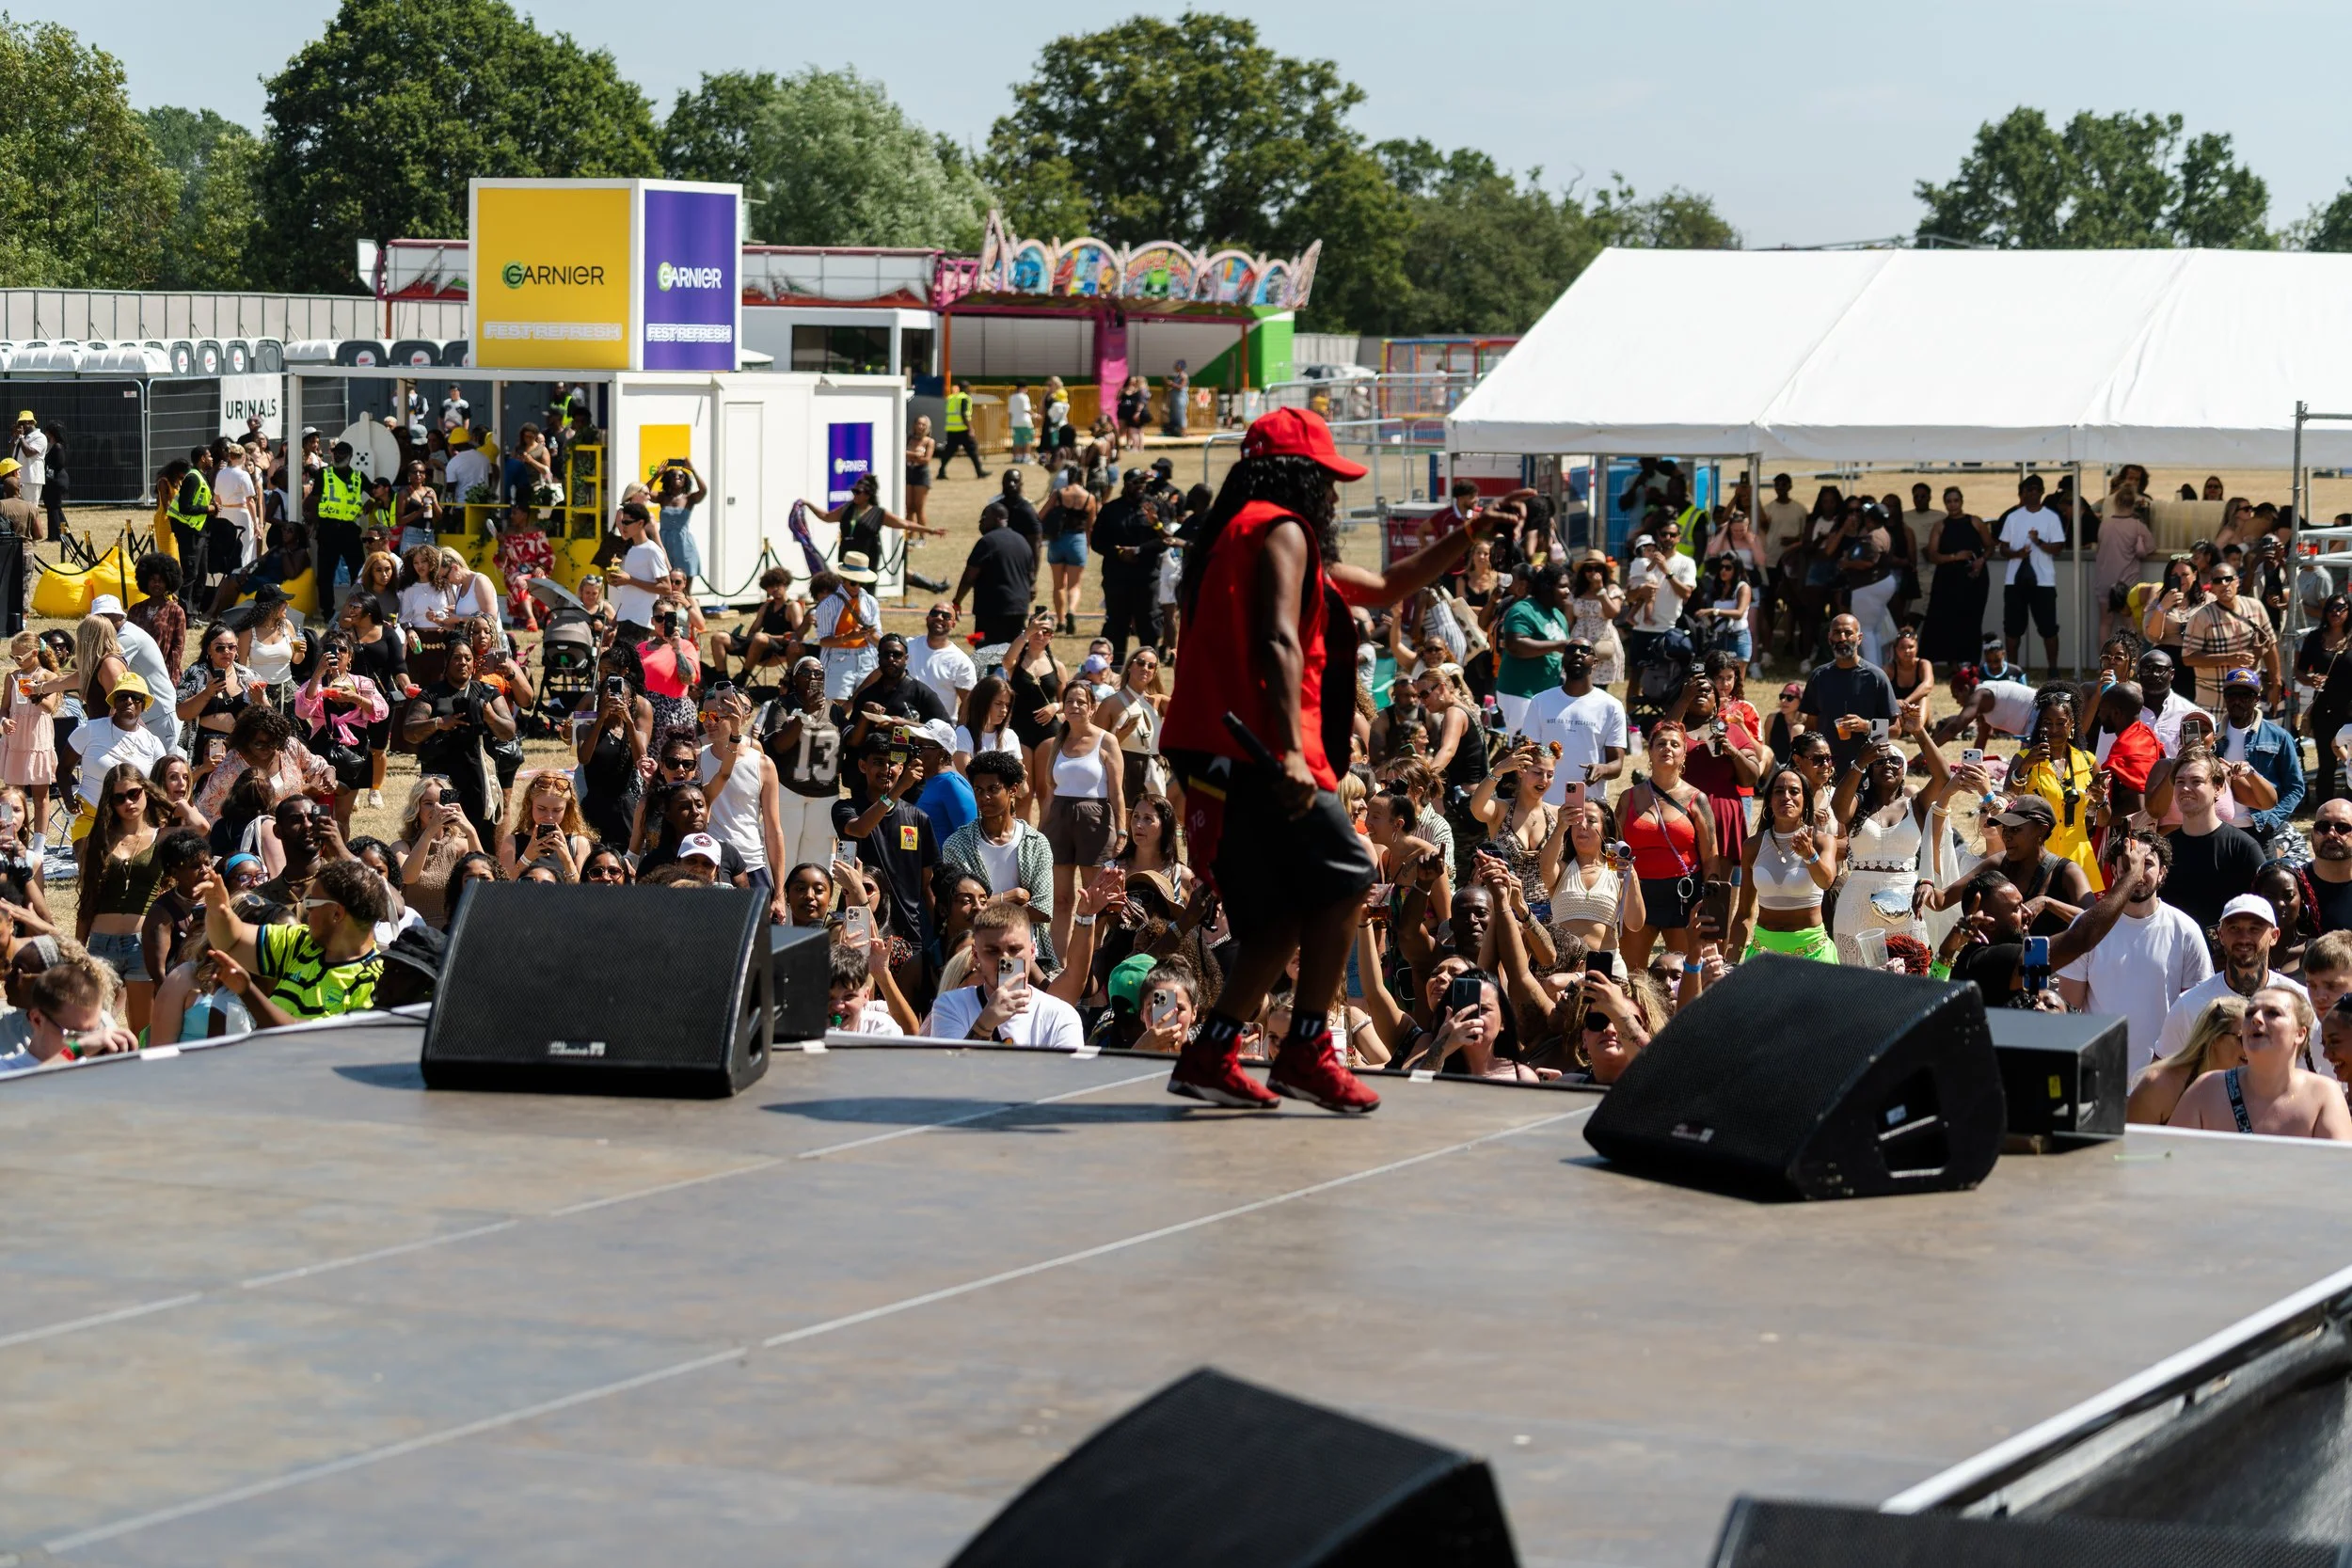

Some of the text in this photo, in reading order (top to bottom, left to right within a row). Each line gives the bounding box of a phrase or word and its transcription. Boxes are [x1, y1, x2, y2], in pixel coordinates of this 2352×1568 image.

[505, 264, 604, 286] GARNIER
[659, 265, 723, 289] GARNIER
[484, 322, 623, 341] FEST REFRESH
[646, 324, 732, 342] FEST REFRESH
[226, 398, 277, 420] URINALS
[793, 730, 840, 782] 13
